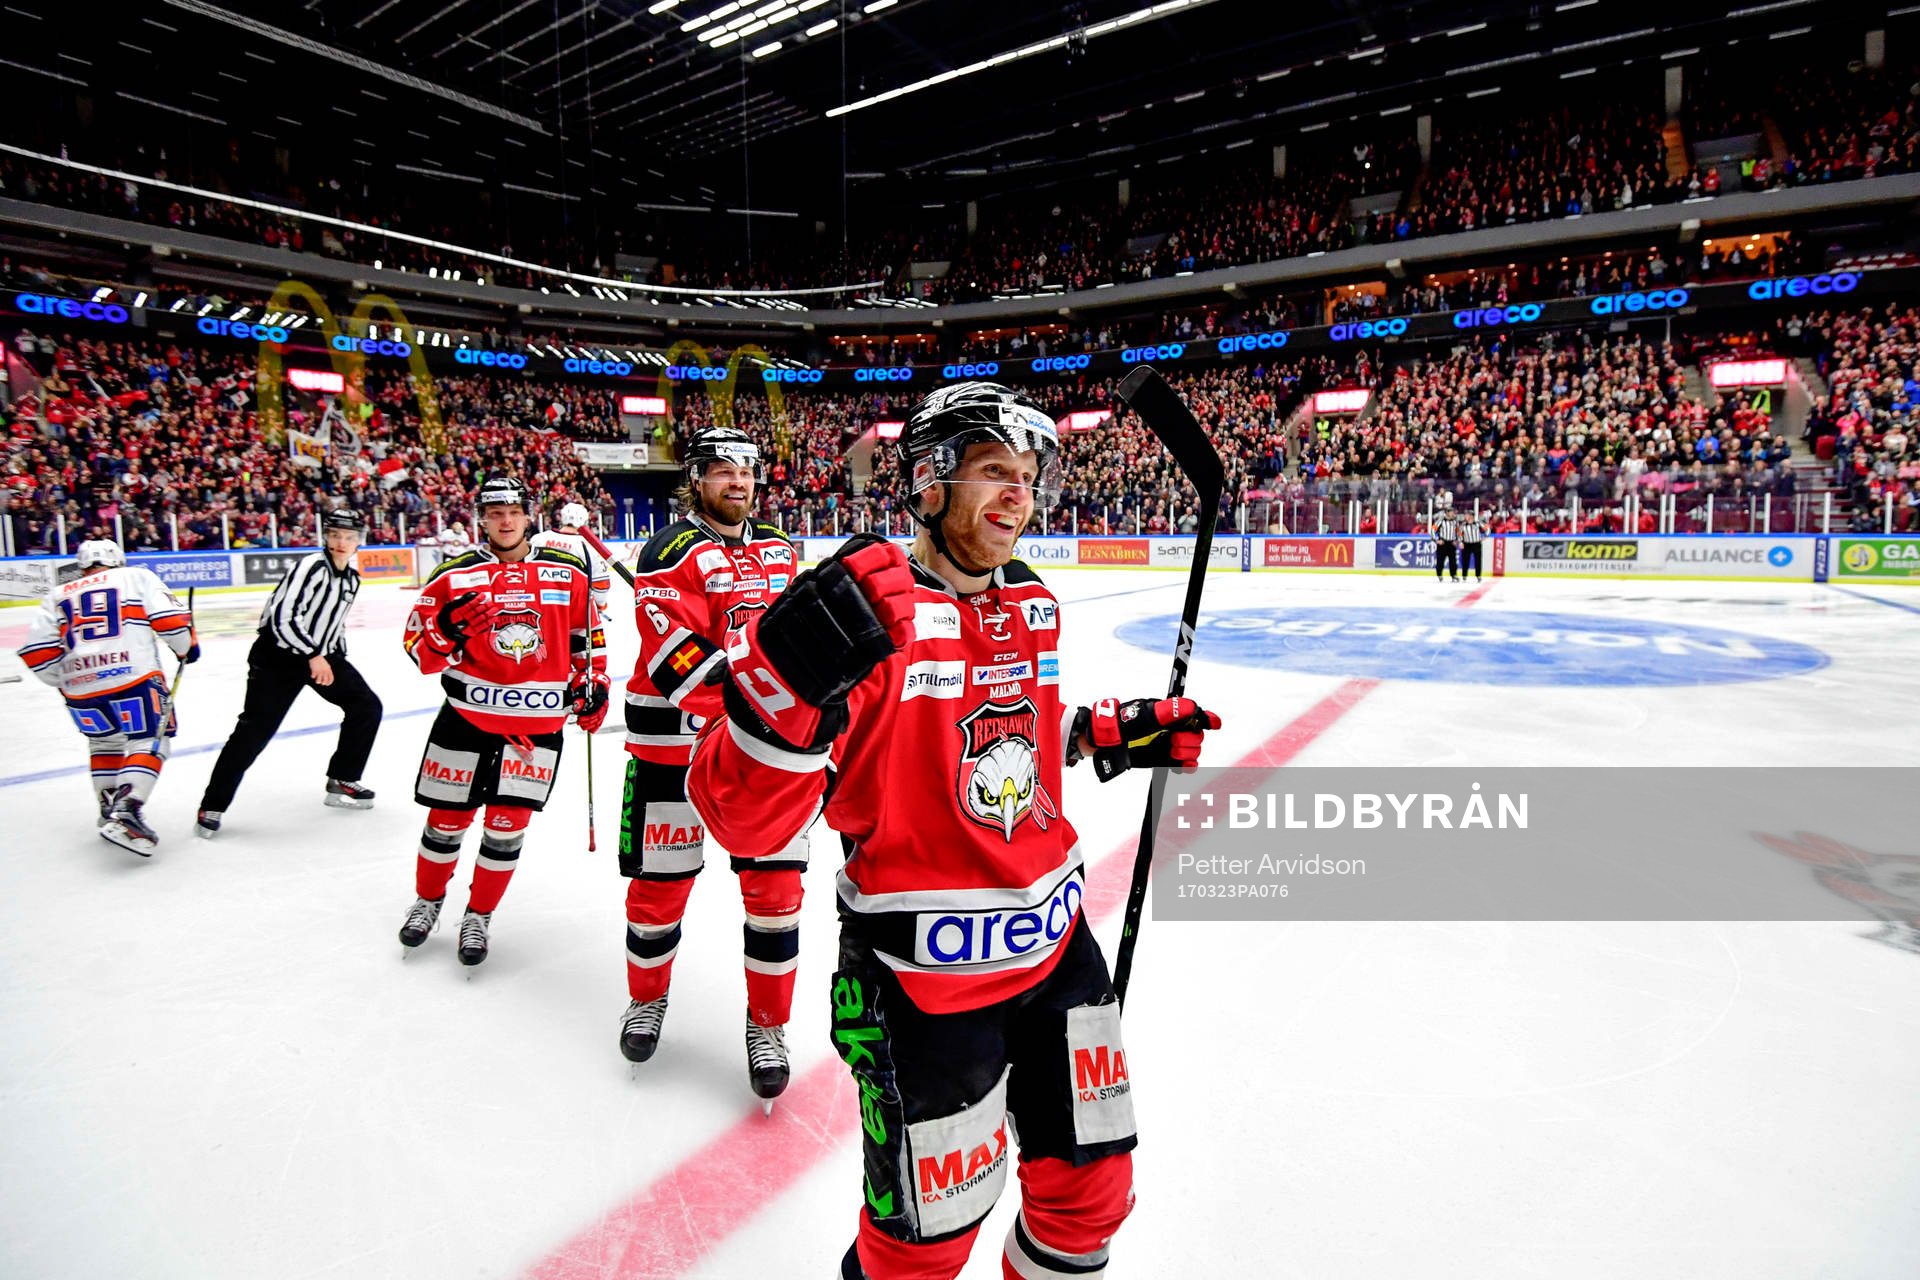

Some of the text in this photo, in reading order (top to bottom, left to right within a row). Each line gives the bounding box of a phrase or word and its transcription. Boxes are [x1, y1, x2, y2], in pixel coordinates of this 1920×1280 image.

[1749, 273, 1862, 300] areco
[16, 290, 128, 323] areco
[1591, 289, 1686, 314] areco
[1454, 304, 1540, 328] areco
[197, 318, 288, 342] areco
[1330, 319, 1407, 341] areco
[333, 336, 411, 357] areco
[1218, 332, 1286, 354] areco
[455, 348, 528, 368] areco
[1121, 344, 1183, 363] areco
[564, 358, 630, 376] areco
[943, 363, 998, 379] areco
[1032, 355, 1089, 372] areco
[666, 366, 727, 381] areco
[763, 368, 822, 383] areco
[854, 368, 912, 382] areco
[1029, 544, 1071, 559] Ocab
[1524, 541, 1637, 558] Tedkomp
[1665, 549, 1764, 563] ALLIANCE
[1883, 544, 1920, 560] GA
[155, 561, 230, 573] SPORTRESOR
[64, 575, 108, 593] MAXI
[970, 593, 992, 606] SHL
[645, 603, 670, 635] 6
[993, 652, 1019, 662] CCM
[988, 665, 1028, 680] INTERSPORT
[471, 687, 560, 708] areco
[989, 681, 1022, 698] MALMÖ
[973, 712, 1034, 753] REDHAWKS
[422, 758, 473, 783] MAXI
[501, 760, 553, 782] MAXI
[927, 881, 1082, 963] areco
[1080, 1090, 1097, 1102] ICA
[918, 1121, 1008, 1193] MAX
[922, 1192, 943, 1204] ICA
